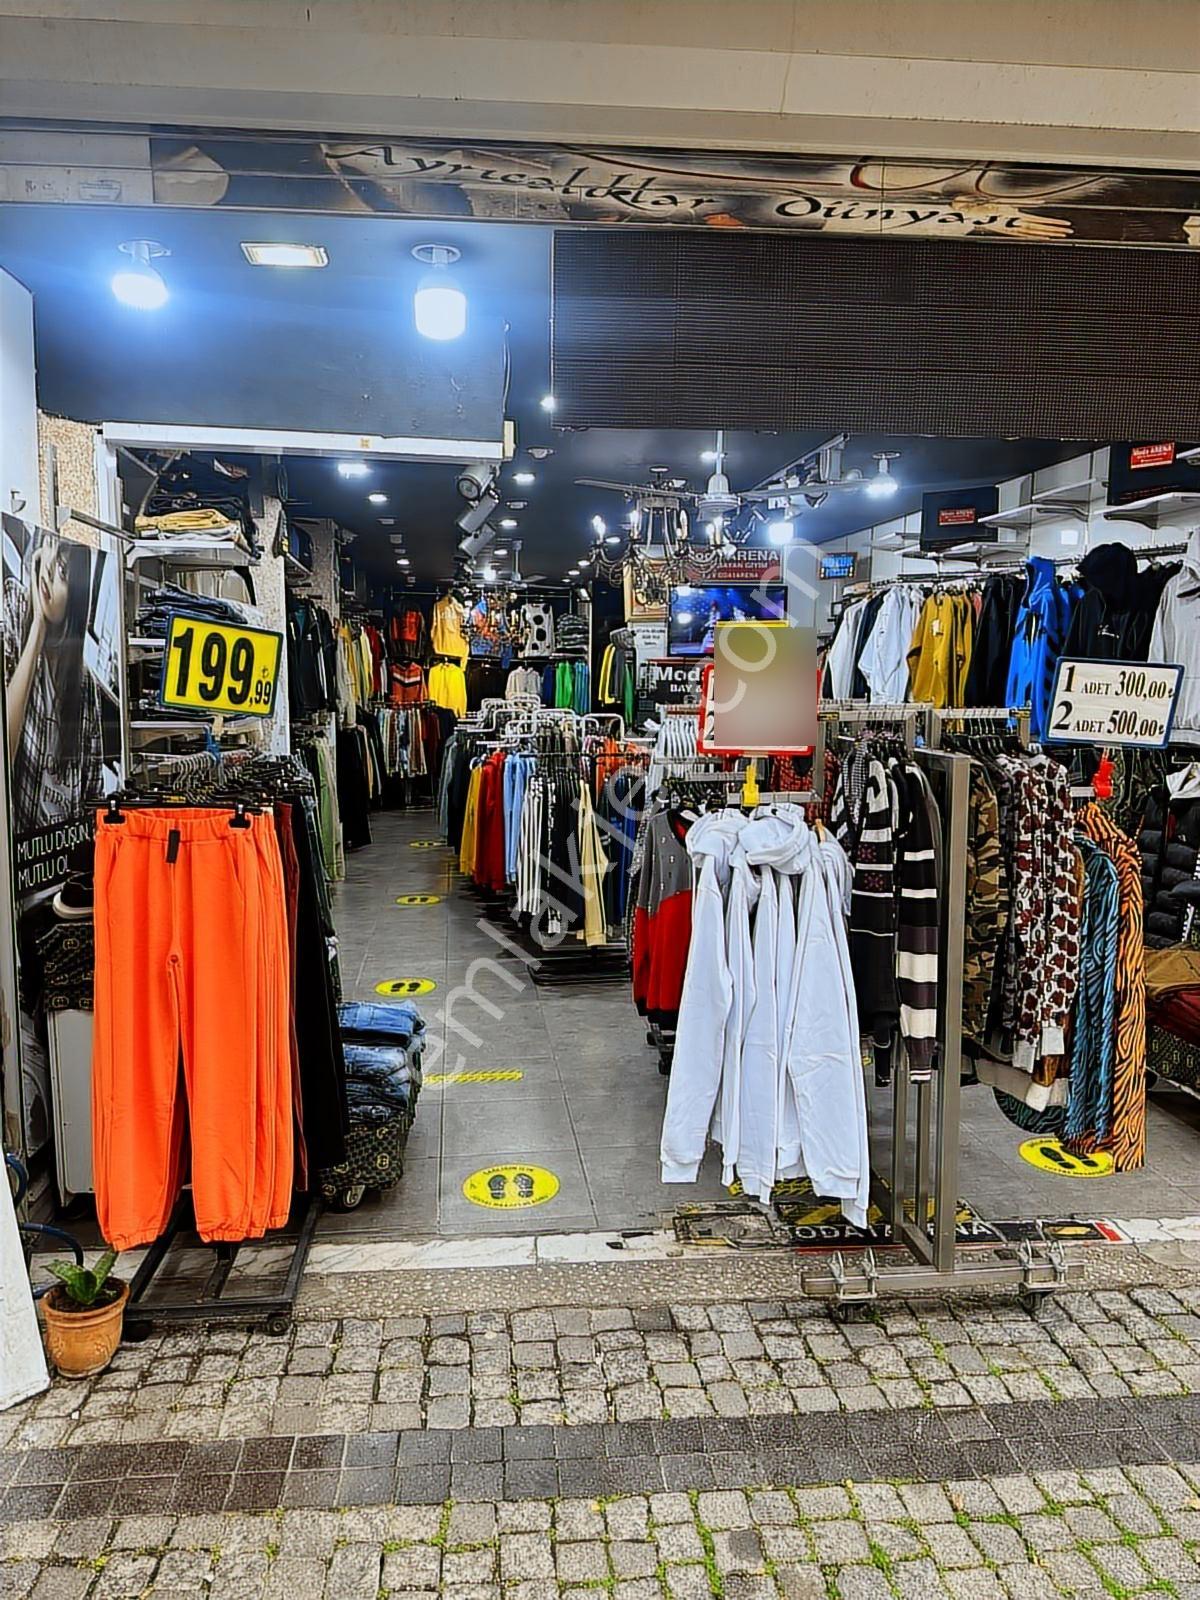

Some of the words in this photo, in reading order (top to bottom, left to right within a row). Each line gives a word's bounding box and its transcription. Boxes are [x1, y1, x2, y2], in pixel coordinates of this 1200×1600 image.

[774, 189, 1024, 231] Dünyası
[656, 666, 704, 681] Mod
[670, 684, 692, 692] BAY
[1060, 665, 1076, 693] 1
[1081, 682, 1112, 695] ADET
[1052, 700, 1073, 730] 2
[1073, 720, 1105, 733] ADET
[17, 833, 53, 863] MUTLU
[18, 859, 55, 891] MUTLU
